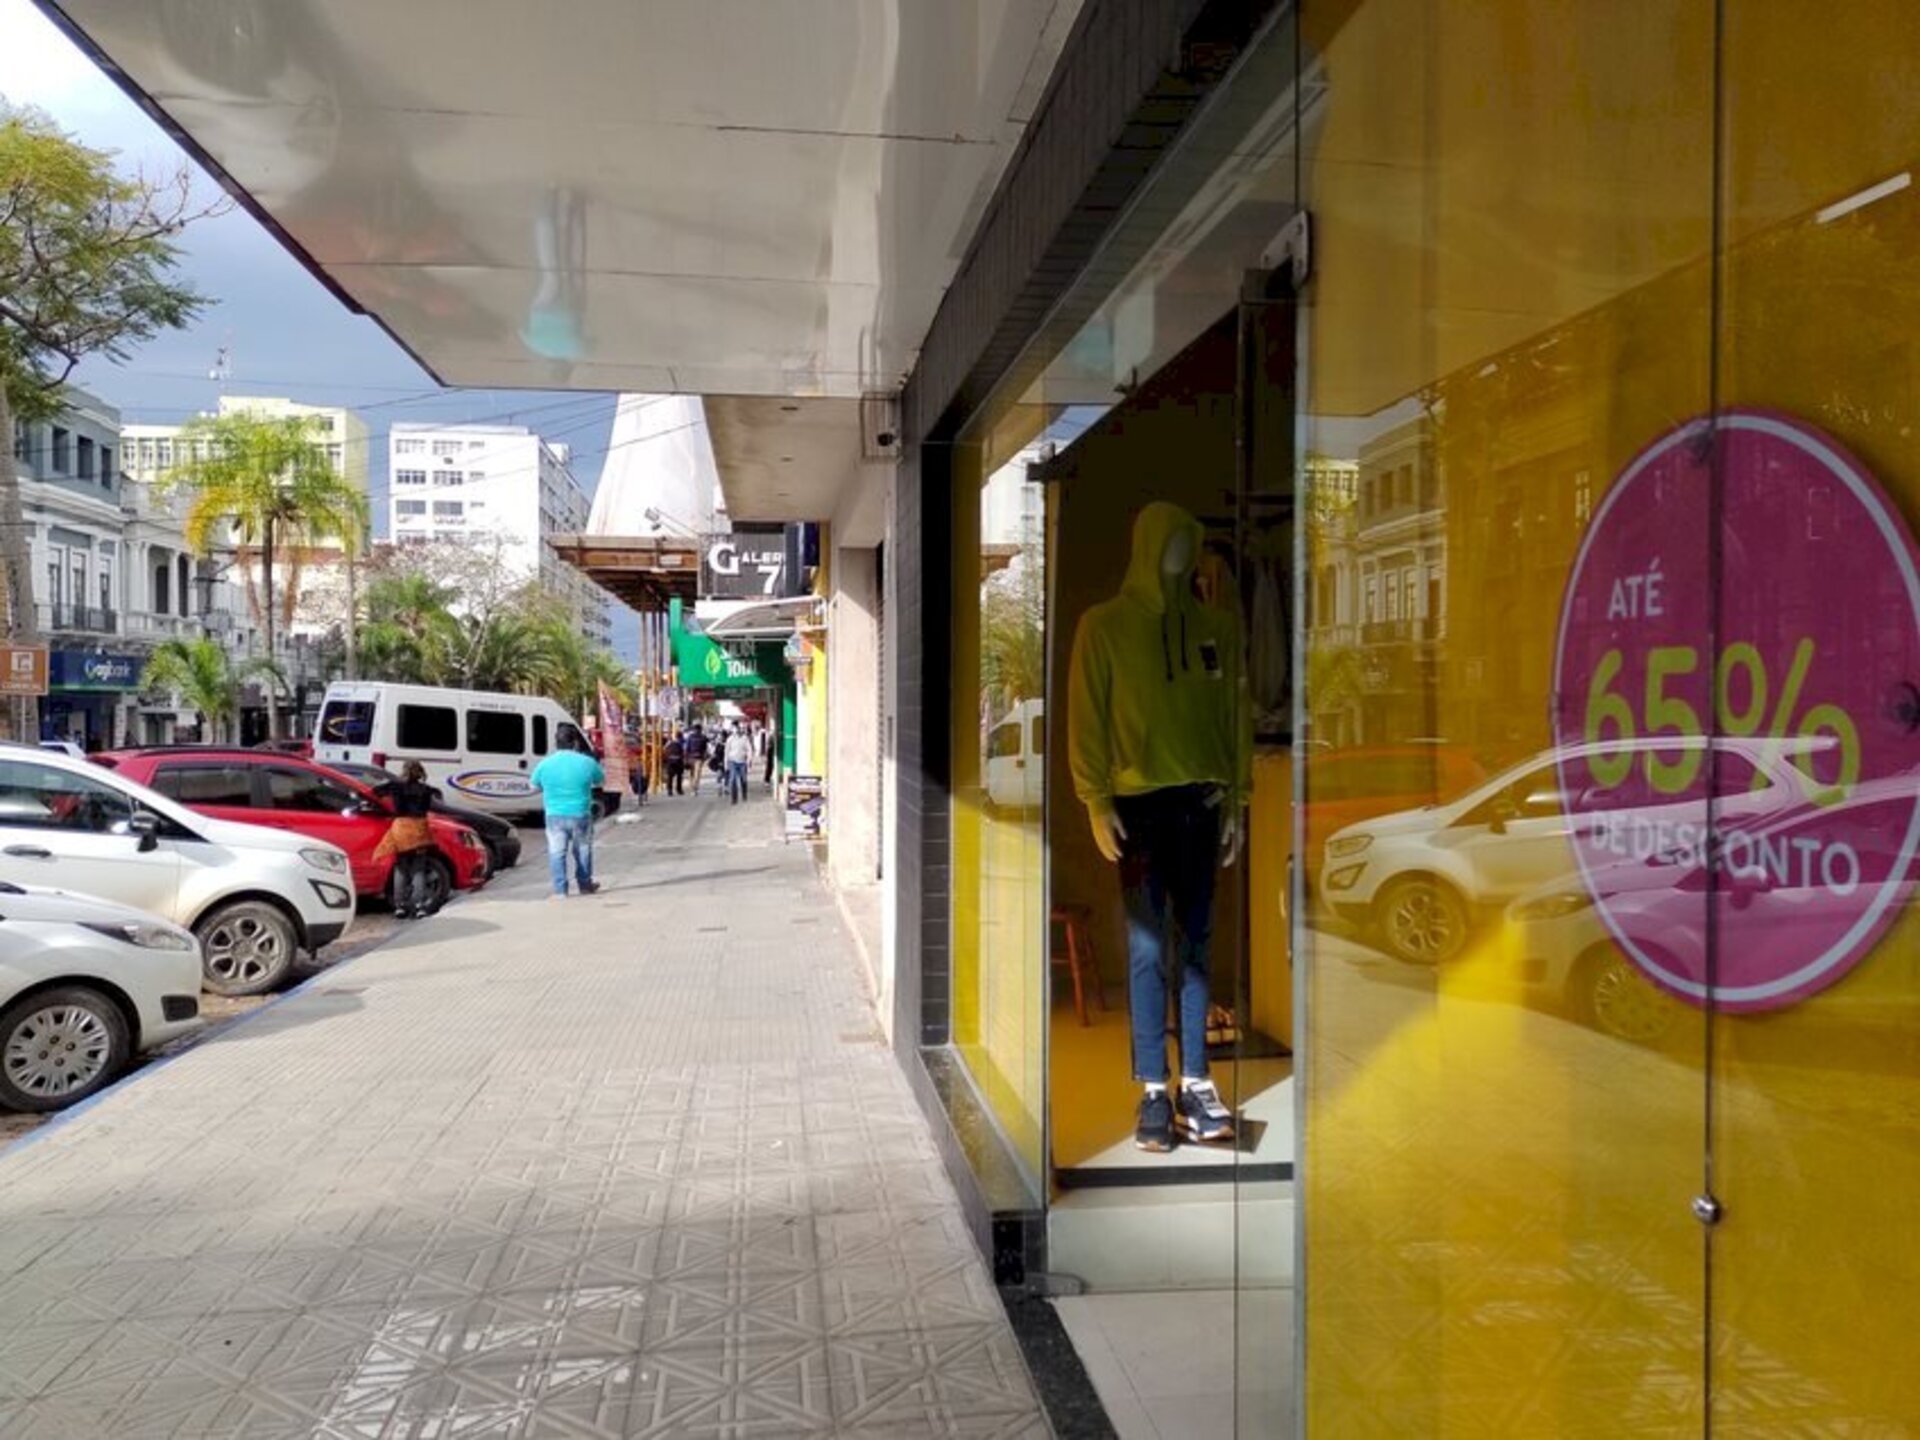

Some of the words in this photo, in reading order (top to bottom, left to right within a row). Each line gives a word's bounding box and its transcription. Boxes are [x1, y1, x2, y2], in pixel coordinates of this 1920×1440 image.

[757, 564, 781, 594] 7
[1607, 557, 1664, 620] ATÉ
[1584, 637, 1861, 807] 65%
[1591, 812, 1628, 851] DE
[1630, 815, 1860, 896] DESCONTO
